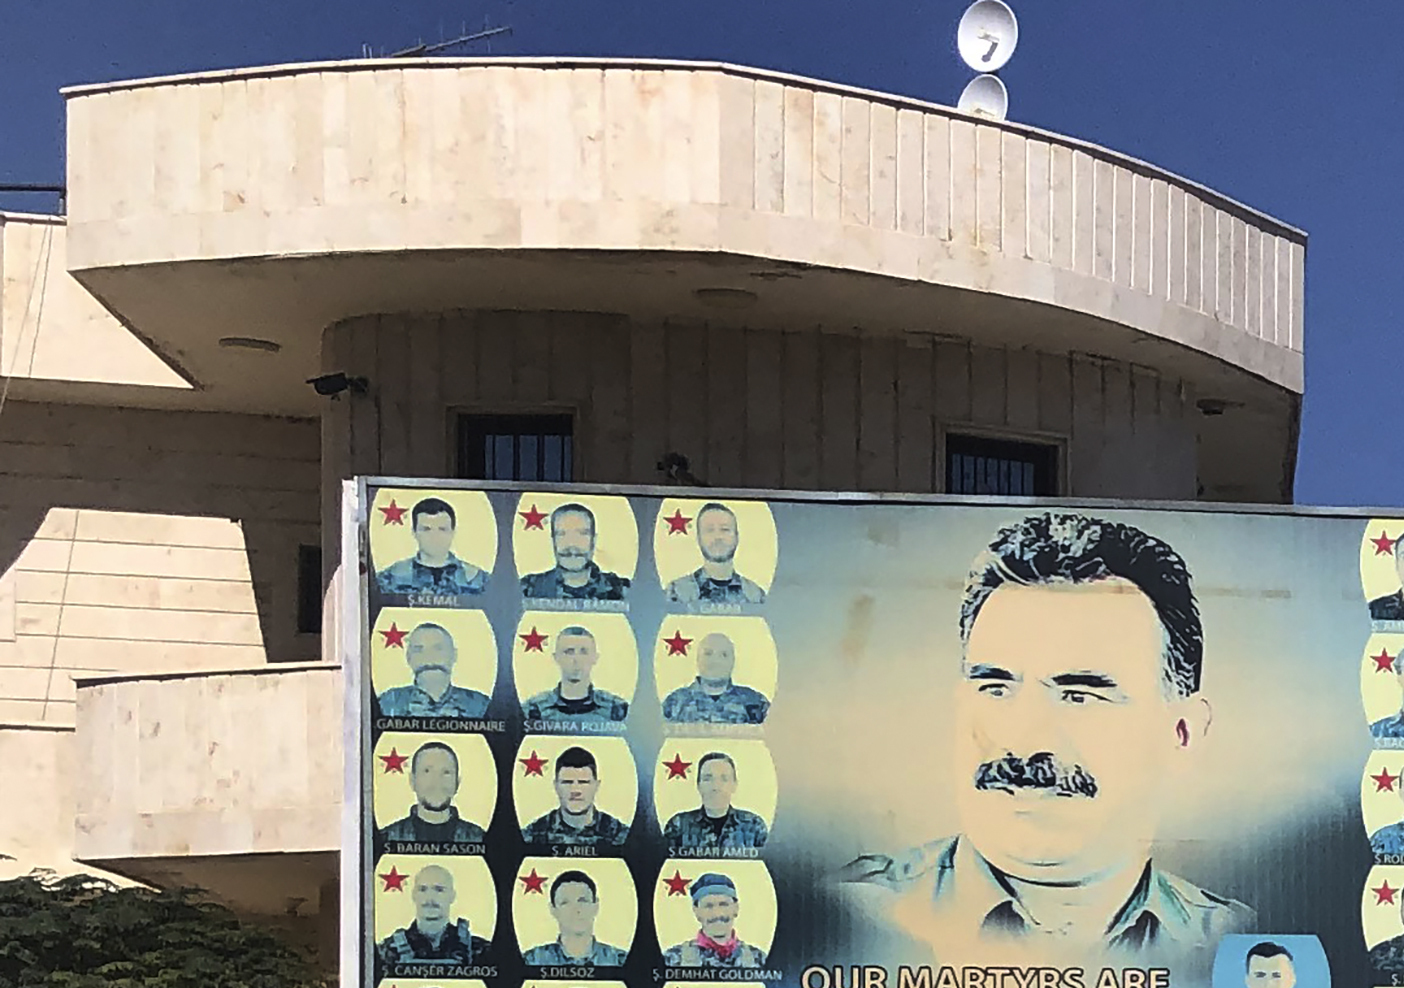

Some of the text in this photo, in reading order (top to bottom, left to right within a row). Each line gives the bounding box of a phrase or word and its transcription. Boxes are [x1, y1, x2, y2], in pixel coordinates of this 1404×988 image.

[377, 718, 420, 730] GABAR
[443, 844, 486, 855] SASON
[565, 846, 599, 856] ARIEL
[447, 966, 498, 977] ZAGROS
[665, 968, 717, 980] DEMHAT
[719, 969, 782, 981] GOLDMAN
